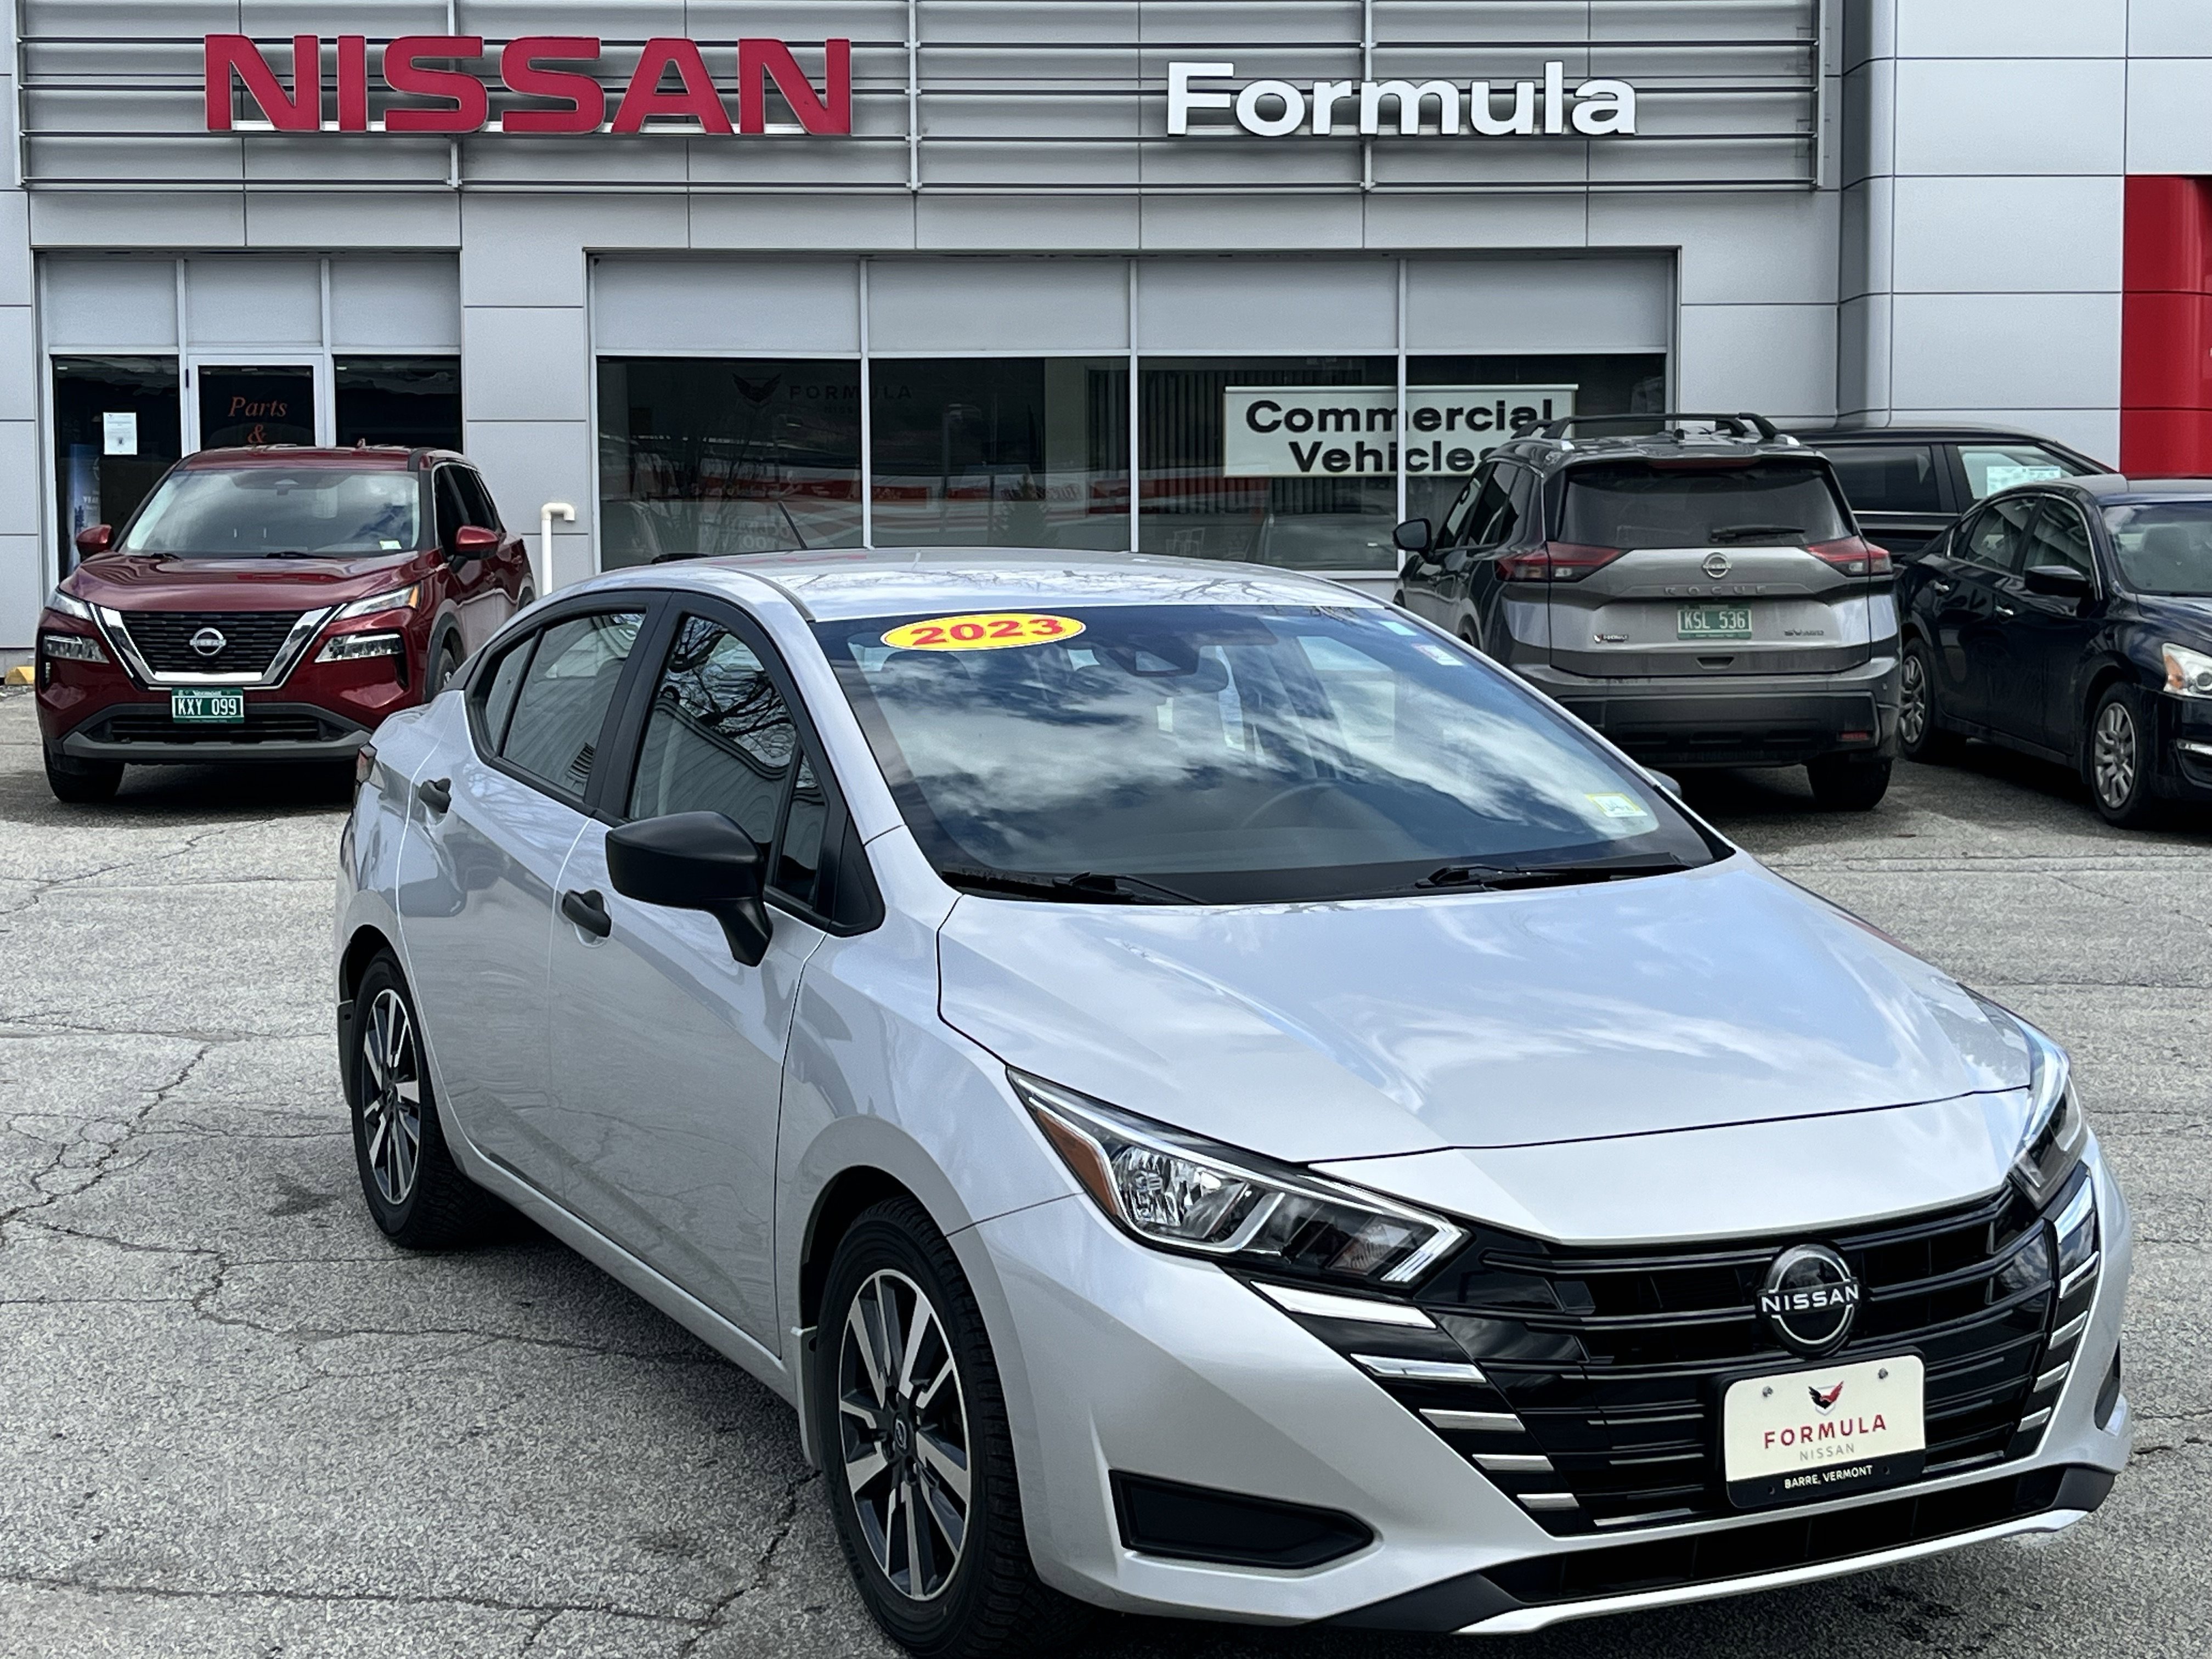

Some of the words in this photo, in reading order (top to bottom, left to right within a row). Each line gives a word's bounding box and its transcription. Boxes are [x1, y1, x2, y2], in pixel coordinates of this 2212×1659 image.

[204, 34, 851, 135] NISSAN
[1166, 61, 1638, 137] Formula
[789, 385, 912, 399] FORMLA
[227, 396, 288, 417] Parts
[1245, 399, 1553, 433] Commercial
[247, 424, 268, 444] &
[1664, 585, 1767, 595] ROGUE
[1684, 611, 1711, 629] KSL
[1718, 611, 1746, 629] 536
[910, 618, 1065, 646] 2023
[178, 698, 202, 715] KXY
[211, 698, 237, 715] 099
[1761, 1284, 1859, 1312] NISSAN
[1764, 1414, 1887, 1449] FORMULA
[1799, 1443, 1855, 1461] NISSAN
[1784, 1474, 1822, 1489] BARRE,
[1822, 1465, 1873, 1482] VERMONT
